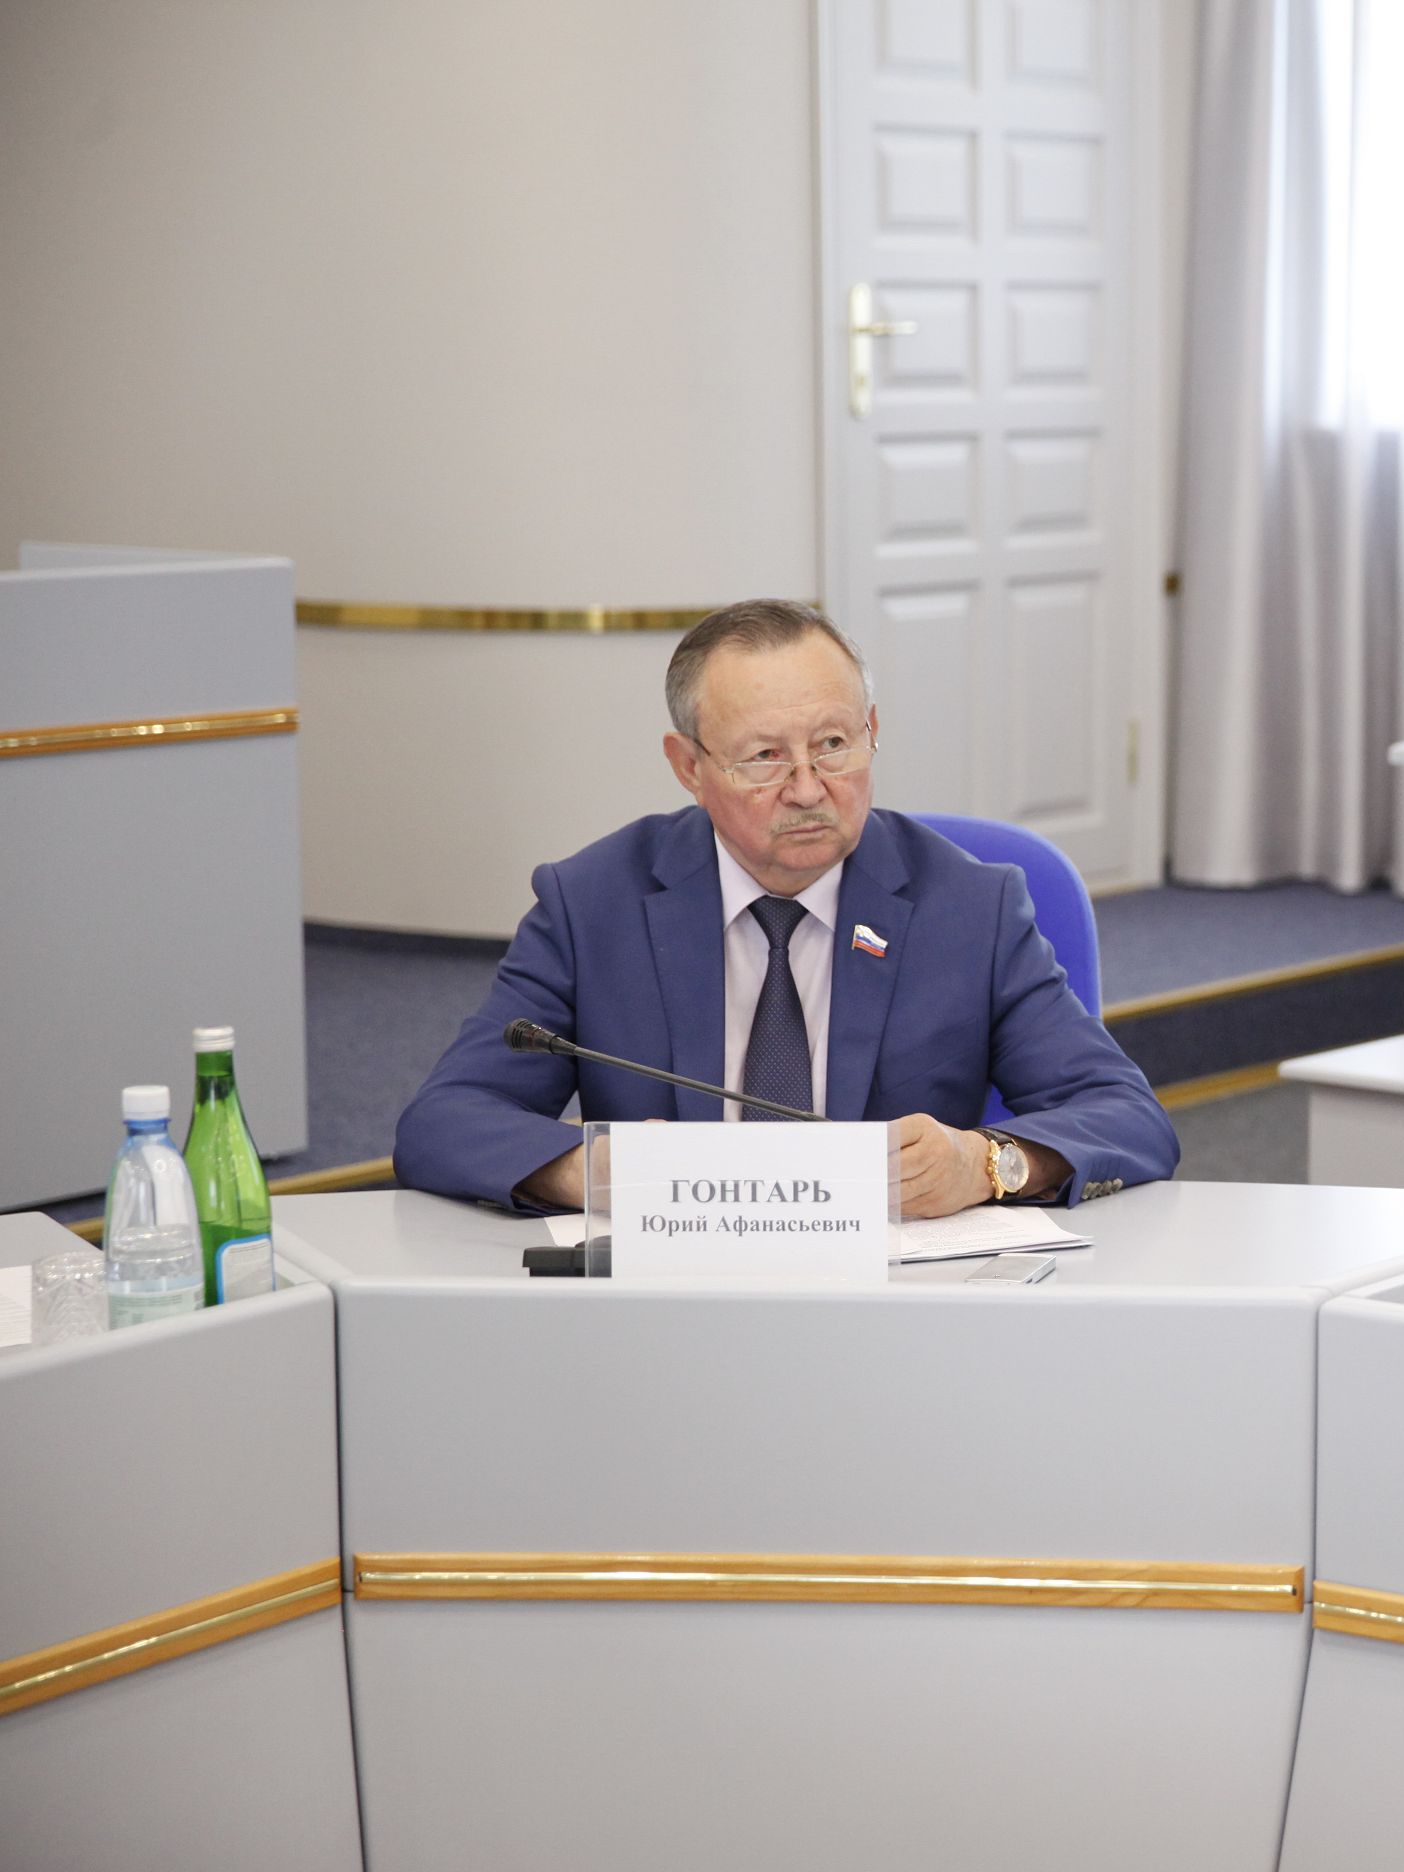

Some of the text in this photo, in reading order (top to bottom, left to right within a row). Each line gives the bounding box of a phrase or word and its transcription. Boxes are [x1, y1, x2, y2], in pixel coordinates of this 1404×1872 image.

[671, 1179, 832, 1203] ГОНТАРЬ
[641, 1214, 861, 1237] Юрий Афанасьевич
